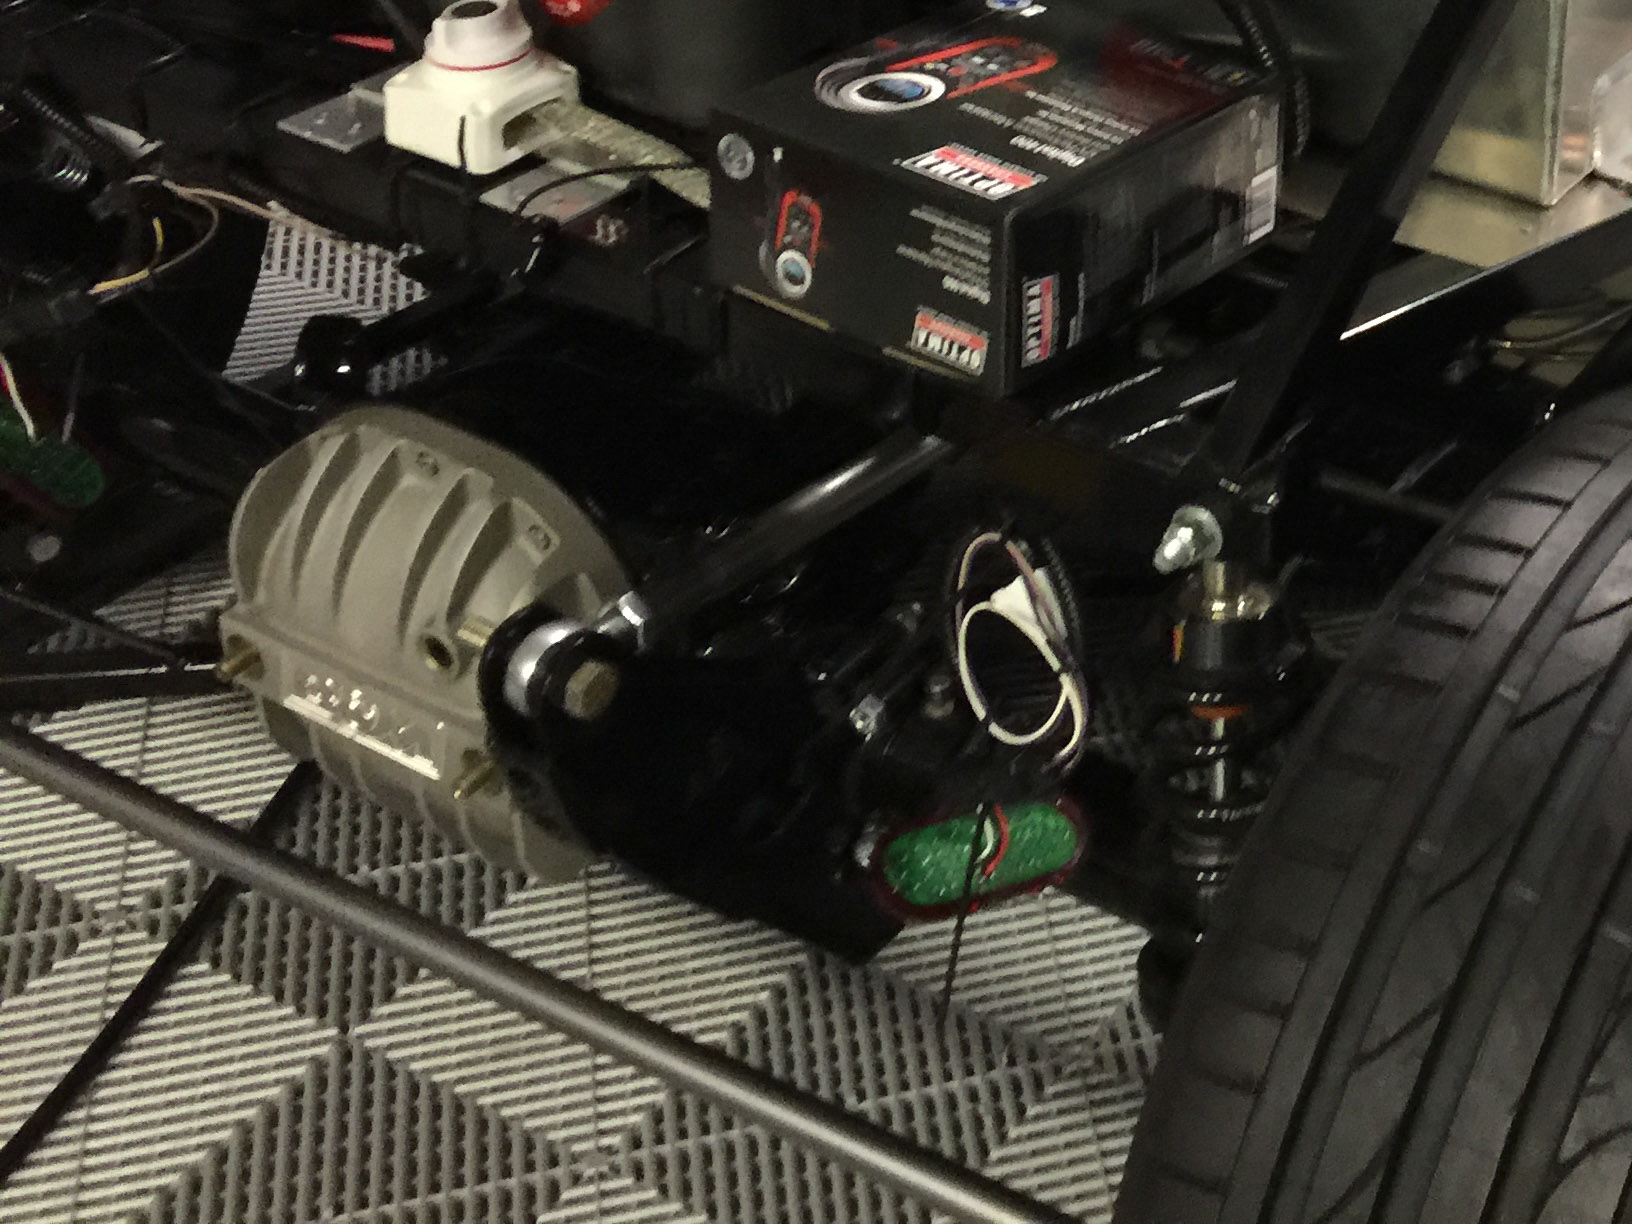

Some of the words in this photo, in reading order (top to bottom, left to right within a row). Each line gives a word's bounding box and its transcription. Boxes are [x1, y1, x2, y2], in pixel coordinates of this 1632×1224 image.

[914, 154, 1017, 196] OPTIMA
[1025, 283, 1042, 361] OPTIMA
[917, 327, 982, 370] OPTIMA
